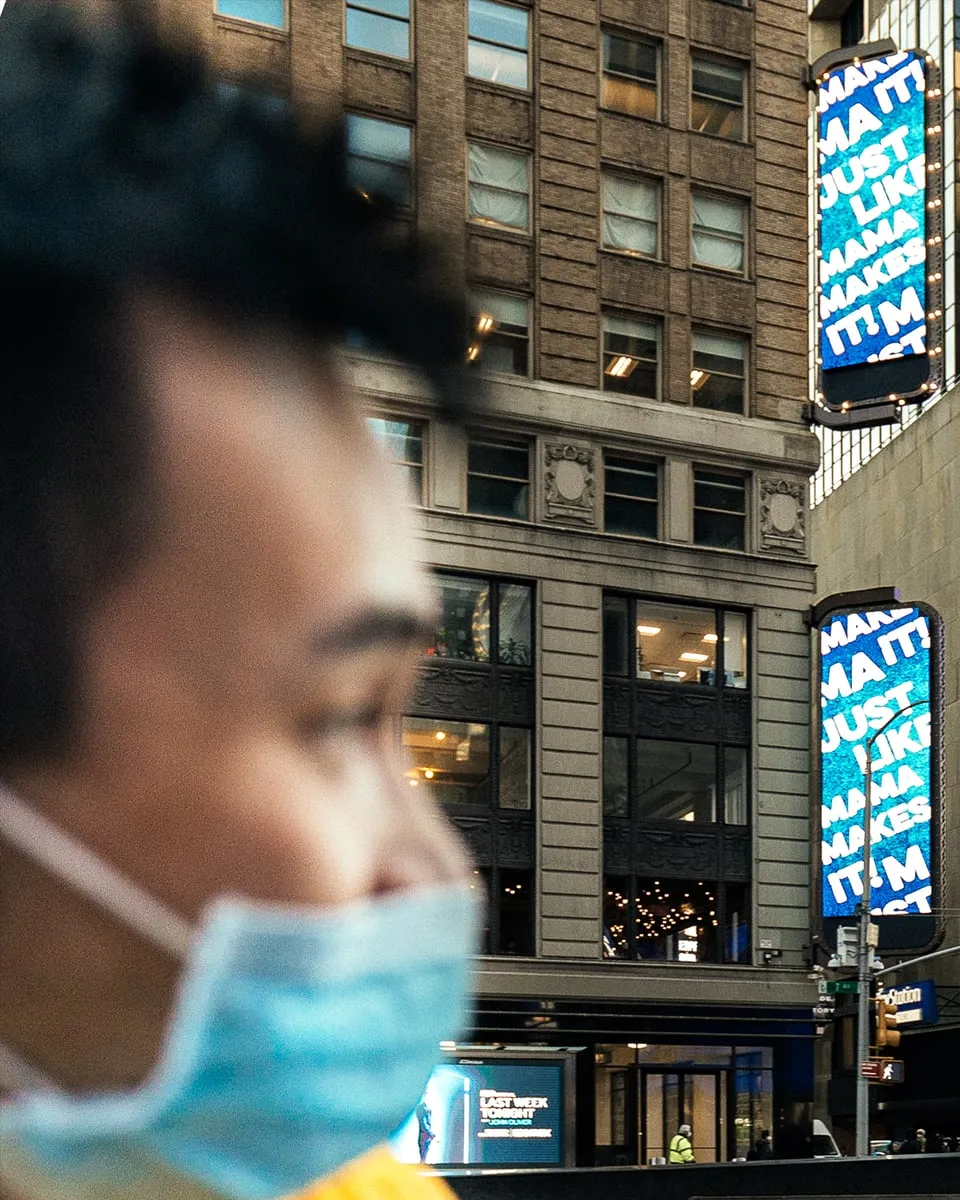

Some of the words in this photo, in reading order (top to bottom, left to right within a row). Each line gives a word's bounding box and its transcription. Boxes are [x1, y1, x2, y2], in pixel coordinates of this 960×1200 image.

[873, 59, 925, 114] IT!
[819, 125, 909, 209] JUST
[819, 208, 919, 284] MAMA
[820, 237, 926, 320] MAKES
[825, 304, 880, 356] IT!
[866, 325, 926, 363] ST
[877, 616, 931, 666] IT!
[821, 681, 914, 753] JUST
[821, 765, 924, 829] MAMA
[821, 795, 931, 865] MAKES
[827, 857, 884, 904] IT!
[870, 886, 932, 916] ST
[480, 1097, 512, 1108] LAST
[513, 1097, 549, 1108] WEEK
[480, 1107, 536, 1118] TONIGHT
